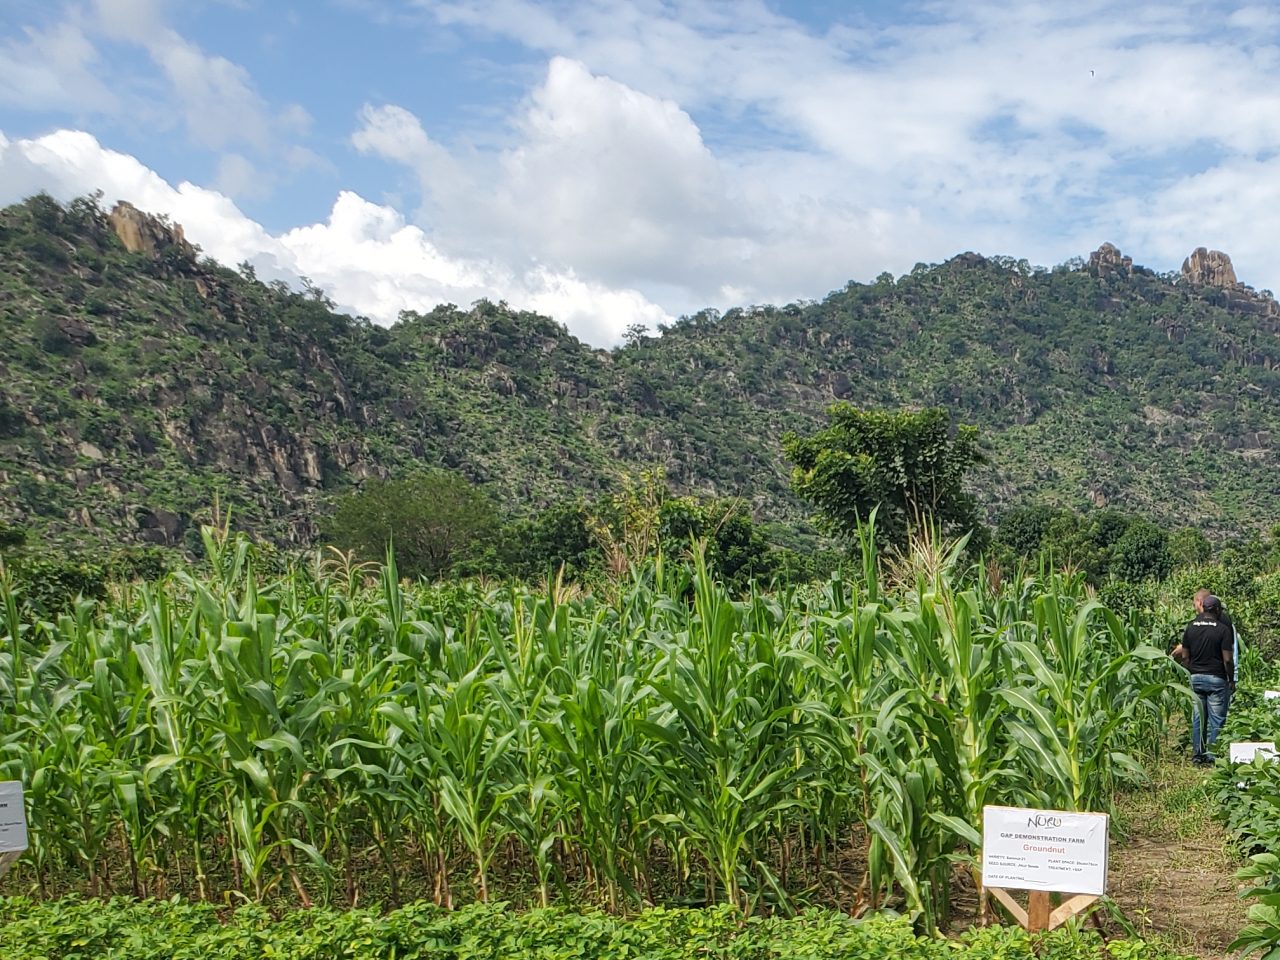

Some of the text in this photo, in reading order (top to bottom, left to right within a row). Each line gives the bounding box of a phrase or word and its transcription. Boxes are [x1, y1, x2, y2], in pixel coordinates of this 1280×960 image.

[1027, 815, 1062, 829] NURU
[1014, 833, 1067, 843] DEMONSTRATION
[1023, 844, 1065, 854] Groundnut
